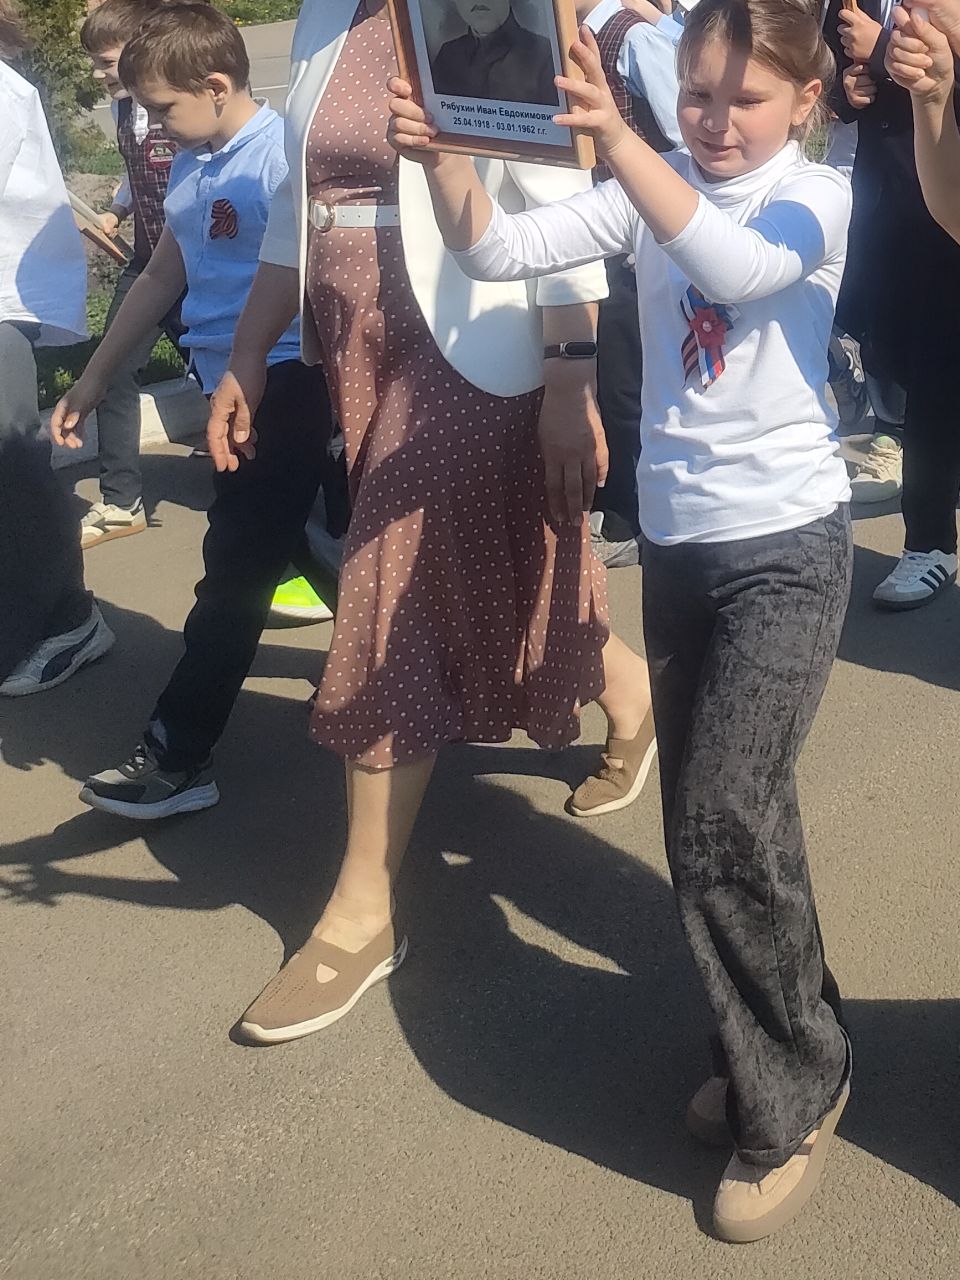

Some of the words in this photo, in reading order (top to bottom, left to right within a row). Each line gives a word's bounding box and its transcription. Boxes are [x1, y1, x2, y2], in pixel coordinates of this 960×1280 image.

[440, 101, 475, 114] Рябухин
[476, 105, 497, 116] Иван
[453, 116, 490, 129] 25.04.1918
[496, 122, 536, 134] 03.01.1962
